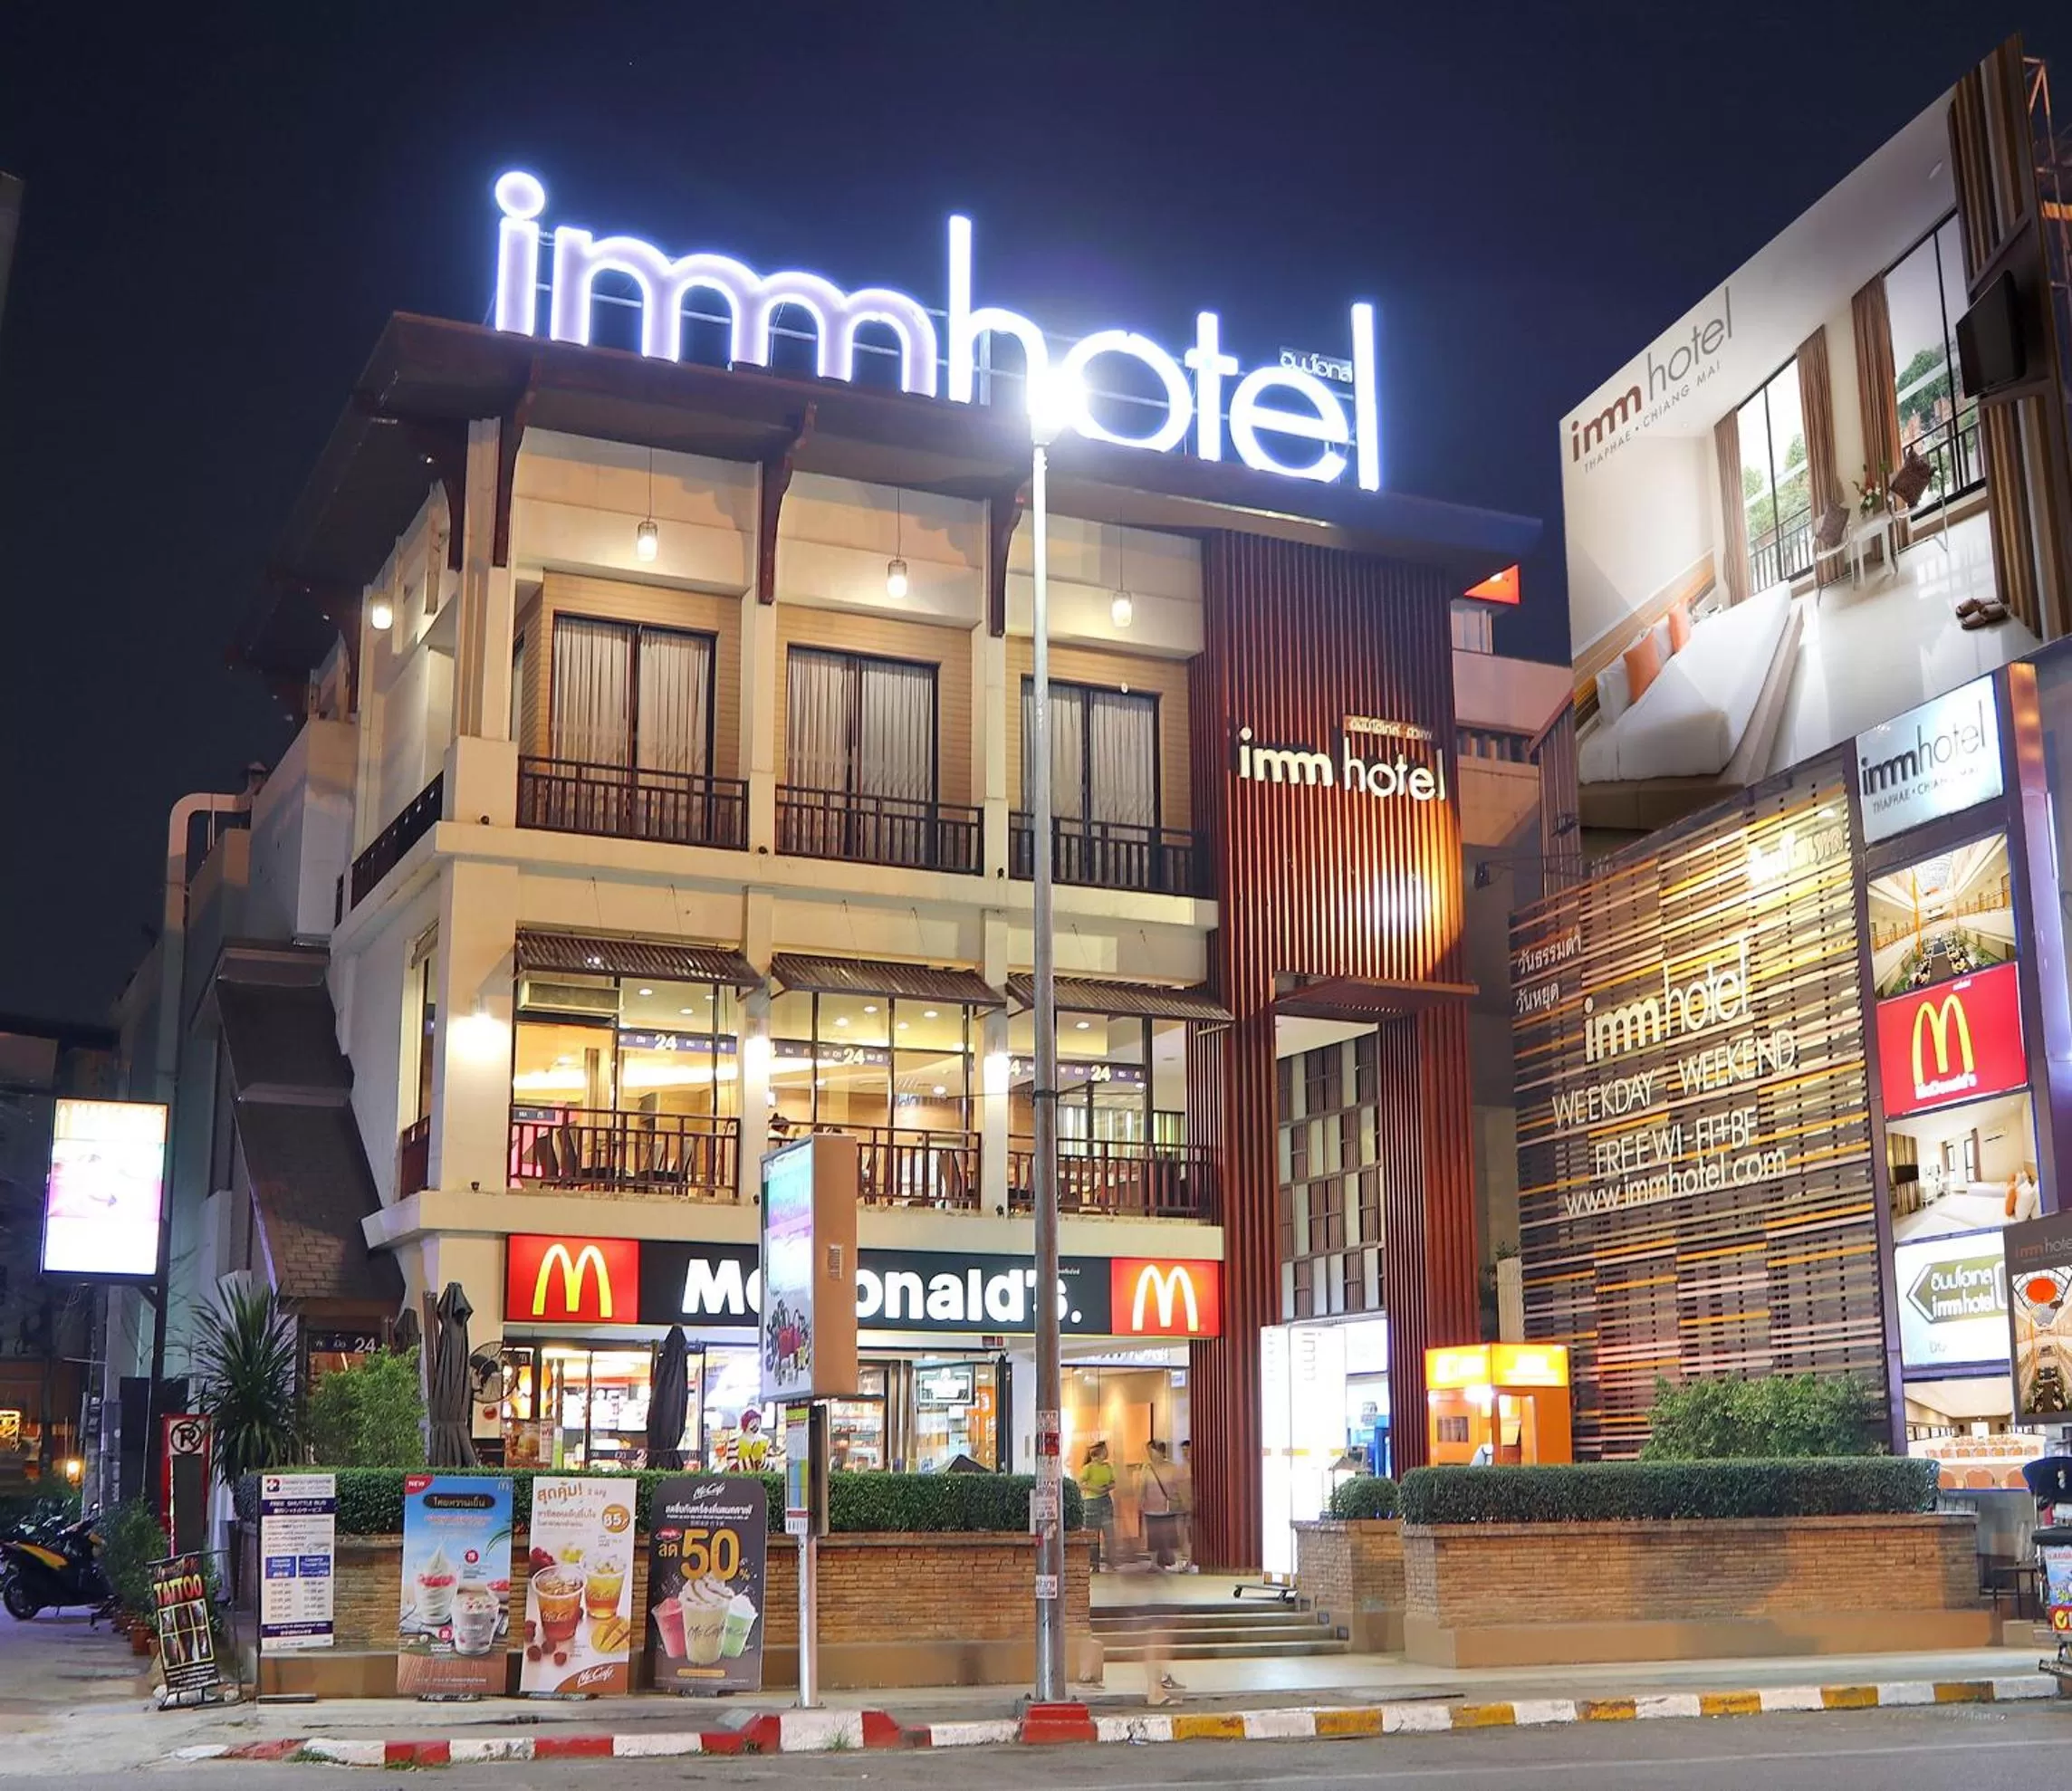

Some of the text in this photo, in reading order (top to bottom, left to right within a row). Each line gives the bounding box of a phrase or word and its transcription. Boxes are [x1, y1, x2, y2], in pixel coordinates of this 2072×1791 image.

[1647, 285, 1732, 401] hotel
[1584, 359, 1721, 473] THAPHAE CHIANG MAI
[1239, 725, 1446, 801] imm hotel
[1917, 698, 1986, 773] hotel
[1552, 1029, 1797, 1129] WEEKDAY WEEKEND
[1565, 1147, 1788, 1217] www.immhotel.com
[1595, 1130, 1651, 1178] FREE
[658, 1543, 678, 1558] ลด
[154, 1573, 203, 1606] TATTOO
